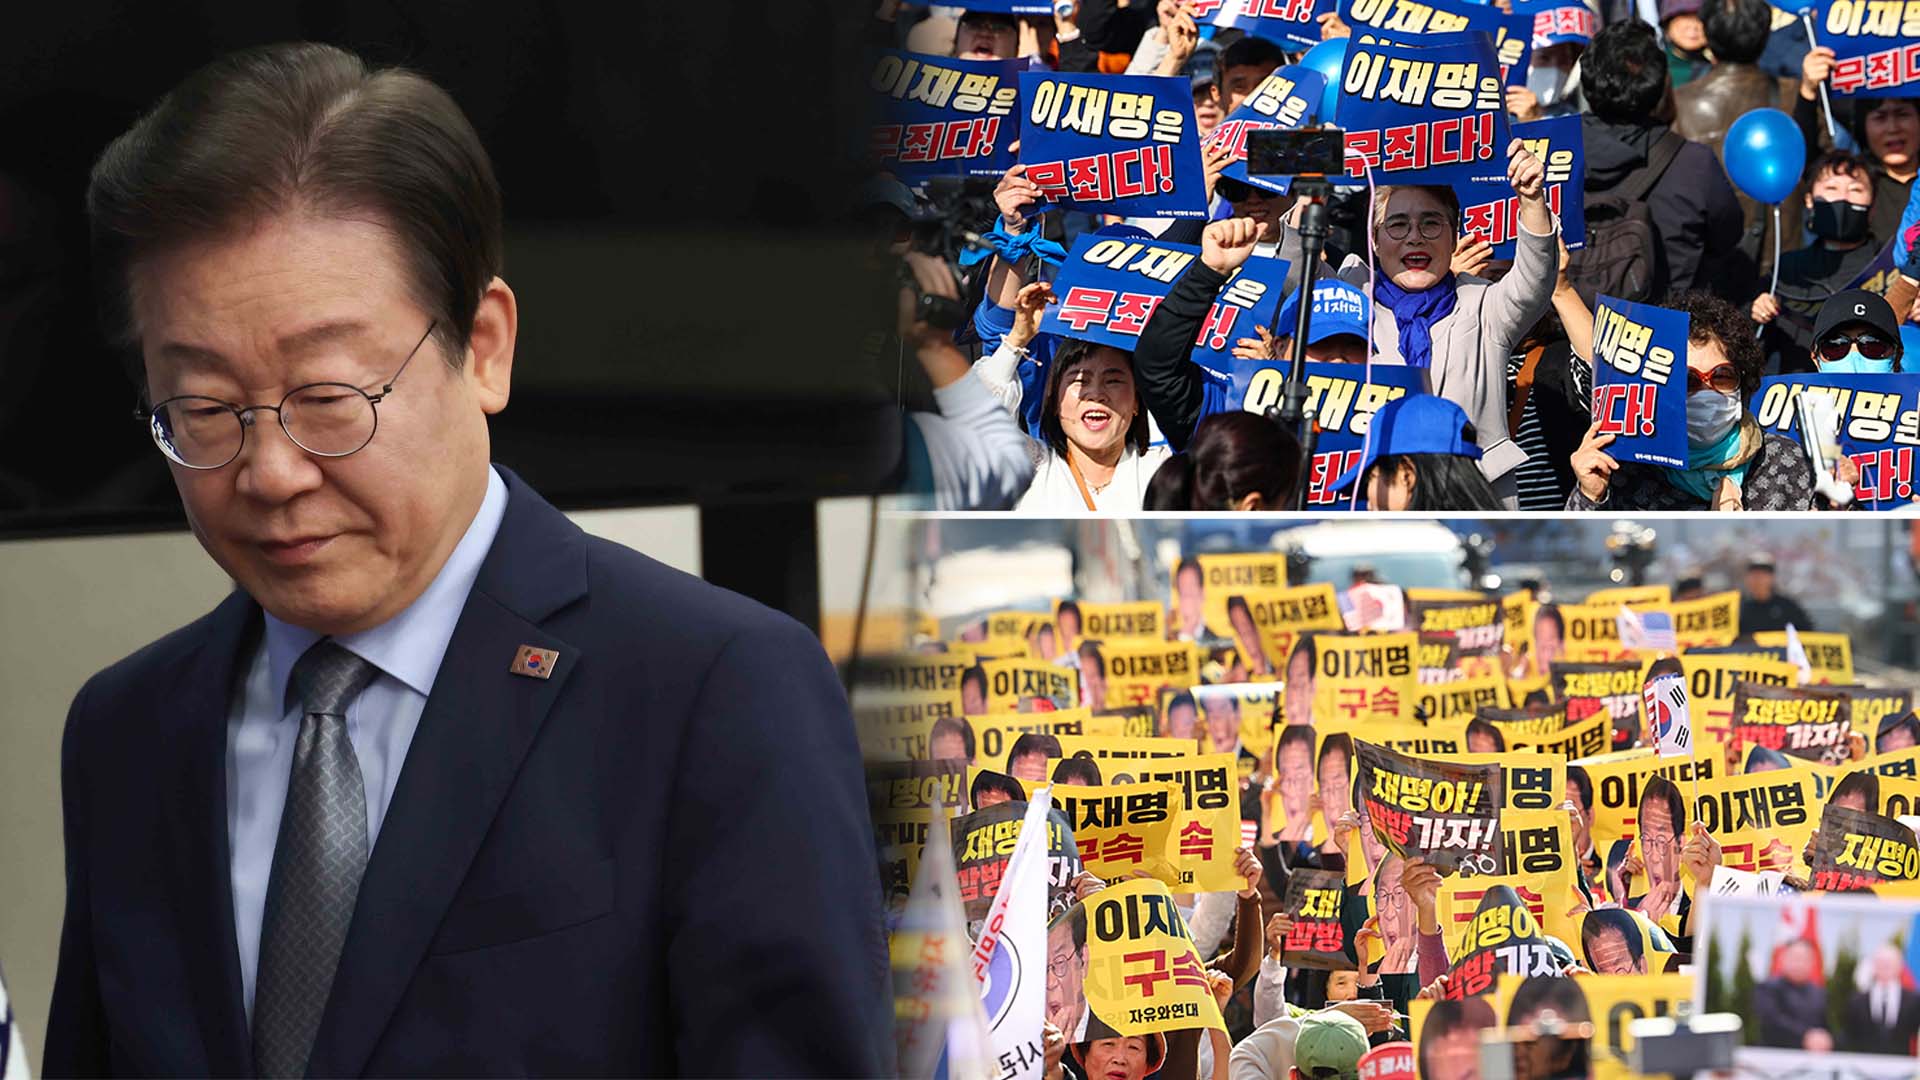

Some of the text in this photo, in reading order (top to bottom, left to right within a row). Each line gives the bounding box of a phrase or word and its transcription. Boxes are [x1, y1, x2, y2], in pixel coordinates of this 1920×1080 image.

[872, 55, 1017, 116] 이재명은
[1242, 75, 1308, 127] 명은
[1344, 50, 1500, 110] 이재명은
[1031, 80, 1183, 144] 이재명은
[871, 117, 1000, 162] 무죄다!
[1343, 111, 1494, 178] 무죄다!
[1025, 144, 1174, 203] 무죄다!
[1083, 239, 1268, 310] 이재은
[1312, 287, 1362, 304] TEAM
[1057, 286, 1240, 351] 무죄!
[1854, 304, 1866, 316] C
[1593, 303, 1675, 385] 이재명은
[1592, 384, 1657, 436] 다!
[1848, 447, 1912, 501] 다!
[1088, 612, 1157, 635] 이재명
[1254, 594, 1330, 628] 이재명
[1111, 650, 1190, 678] 이재명
[1322, 645, 1411, 679] 이재명
[1338, 685, 1400, 718] 구속
[1372, 767, 1483, 814] 재명아!
[1694, 782, 1807, 834] 이재명
[961, 819, 1062, 863] 재명!
[1179, 820, 1214, 861] 속
[1095, 894, 1187, 943] 이재
[1123, 949, 1212, 998] 구속
[1129, 1002, 1199, 1024] 자유와연대
